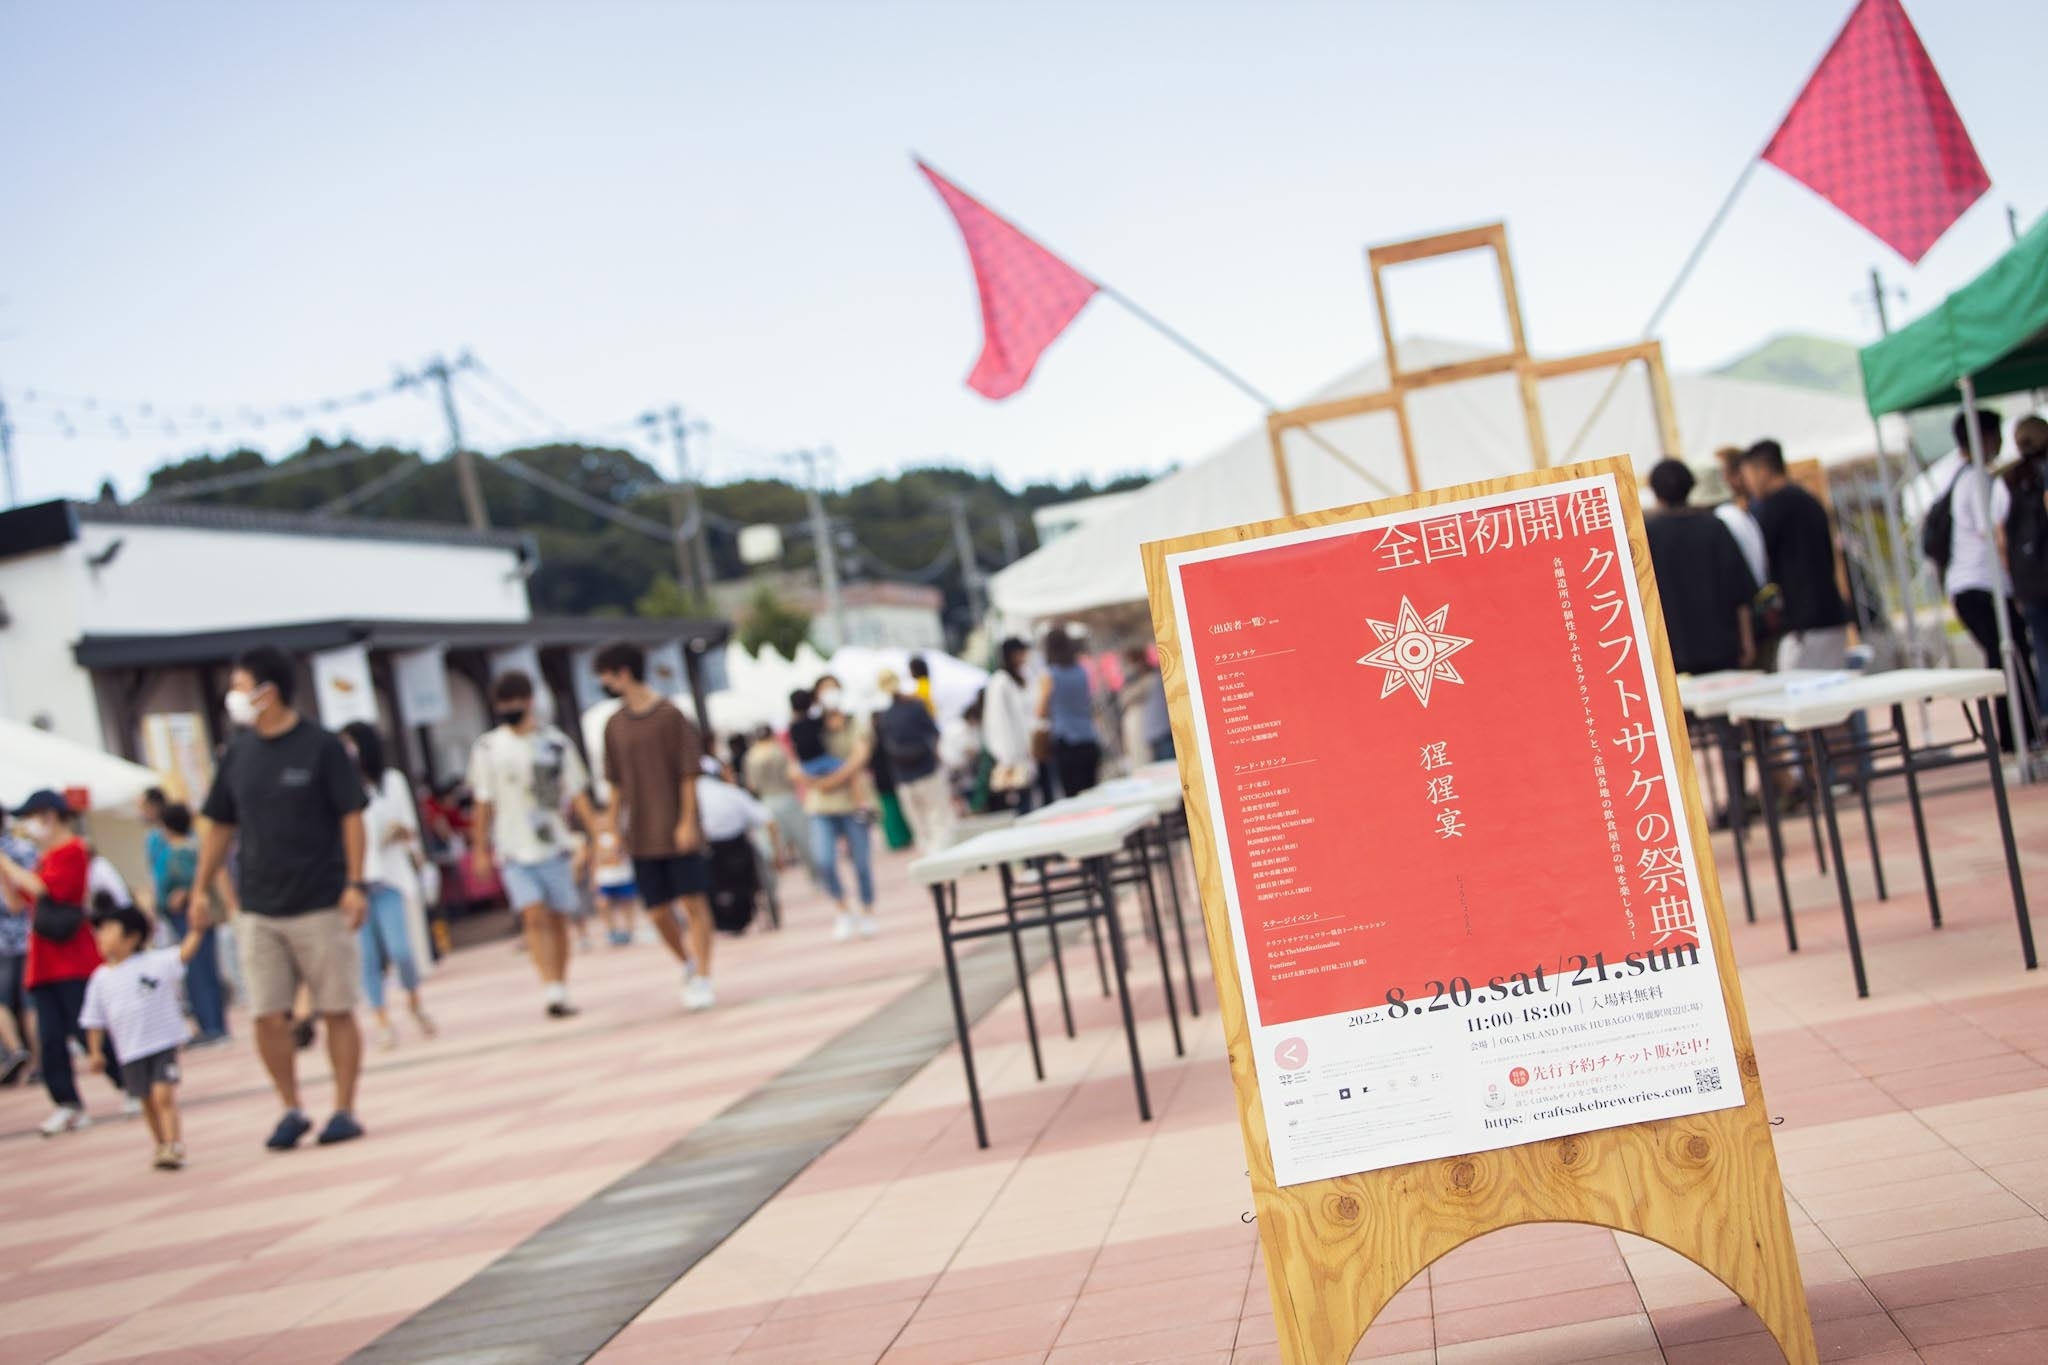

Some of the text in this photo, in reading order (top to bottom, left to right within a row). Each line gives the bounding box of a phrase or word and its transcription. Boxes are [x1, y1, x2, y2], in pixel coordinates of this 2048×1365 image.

[1371, 487, 1614, 572] 全国初開催
[1214, 648, 1255, 662] クラフトサケ
[1226, 719, 1281, 734] LAGOON BREWERY
[1581, 547, 1698, 945] クラフトサケの祭典
[1420, 740, 1465, 838] 猩猩宴
[1262, 911, 1318, 927] ステージイベント
[1348, 1012, 1384, 1028] 2022.
[1466, 985, 1663, 1032] 11:00-18:00 入場料無料
[1499, 1035, 1521, 1046] OGA
[1523, 1028, 1559, 1041] ISLAND
[1561, 1022, 1588, 1035] PARK
